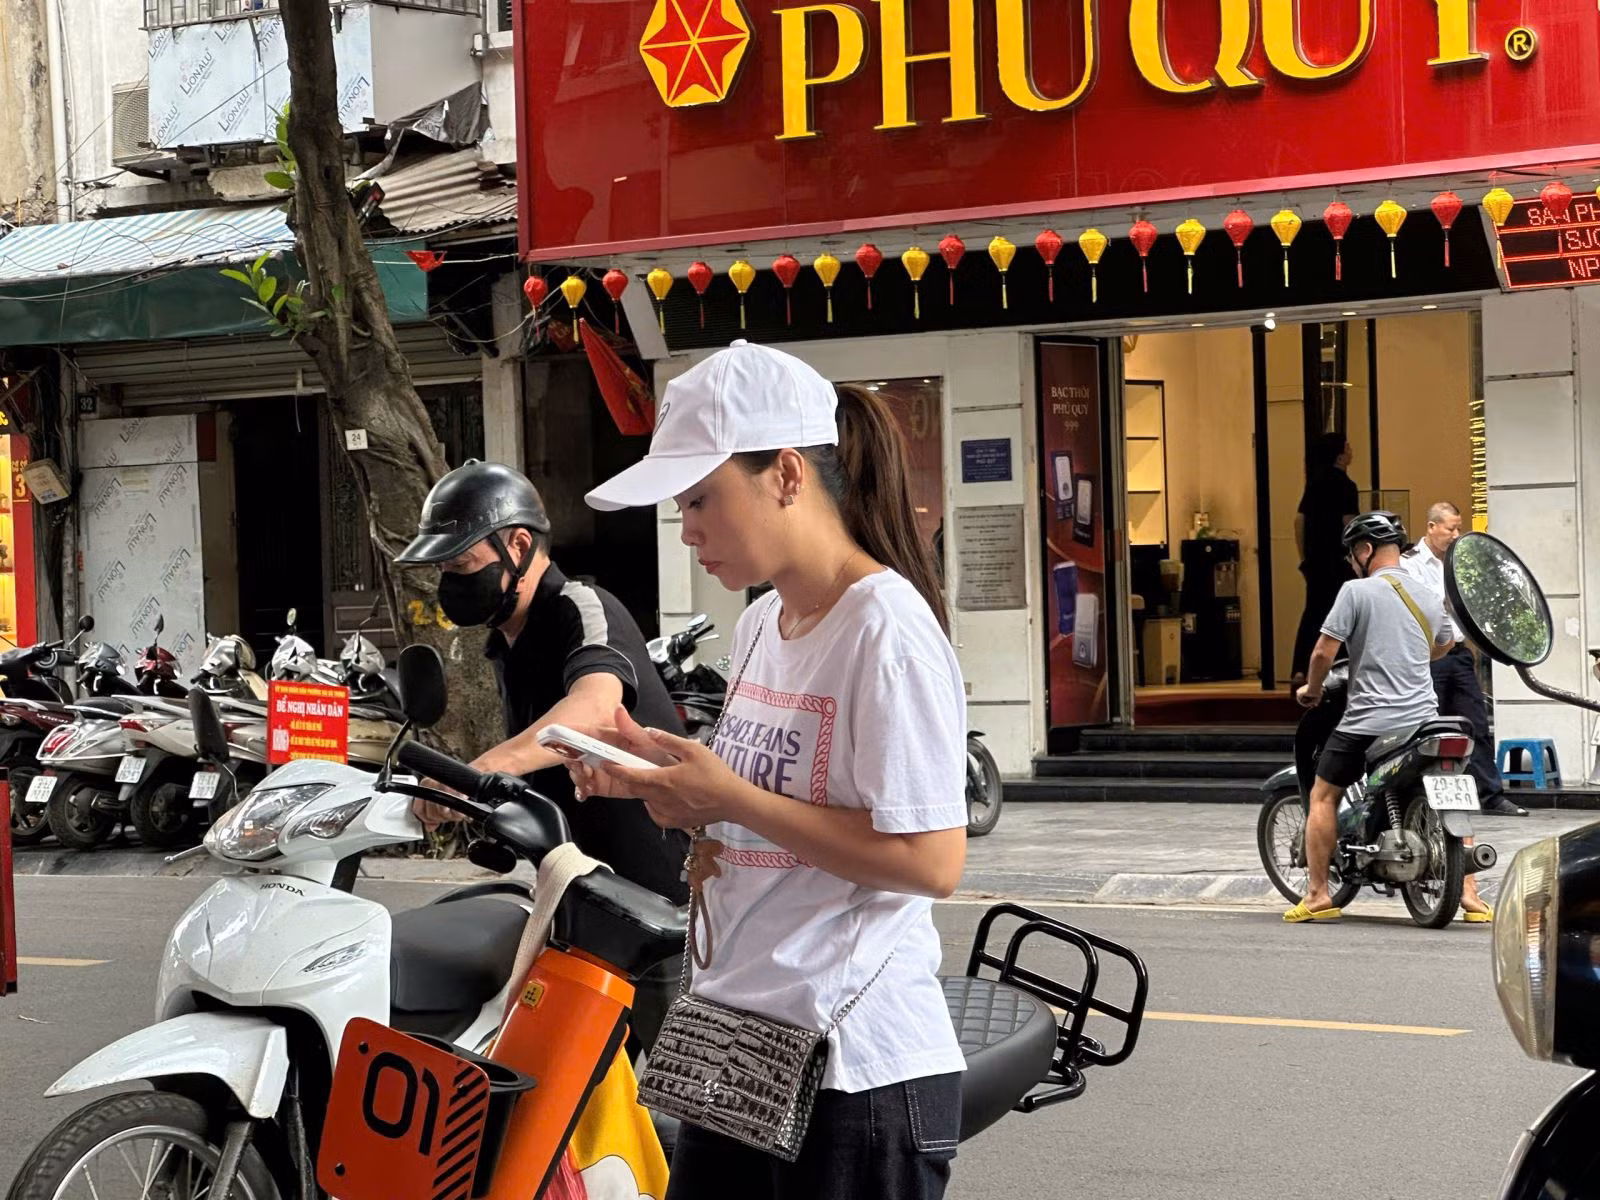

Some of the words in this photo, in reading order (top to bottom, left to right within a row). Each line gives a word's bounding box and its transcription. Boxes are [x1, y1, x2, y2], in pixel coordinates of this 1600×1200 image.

[180, 52, 213, 95] LIONALU
[218, 89, 249, 132] LIONALU
[748, 722, 802, 757] JEANS
[260, 882, 305, 897] HONDA
[362, 1051, 441, 1157] 01
